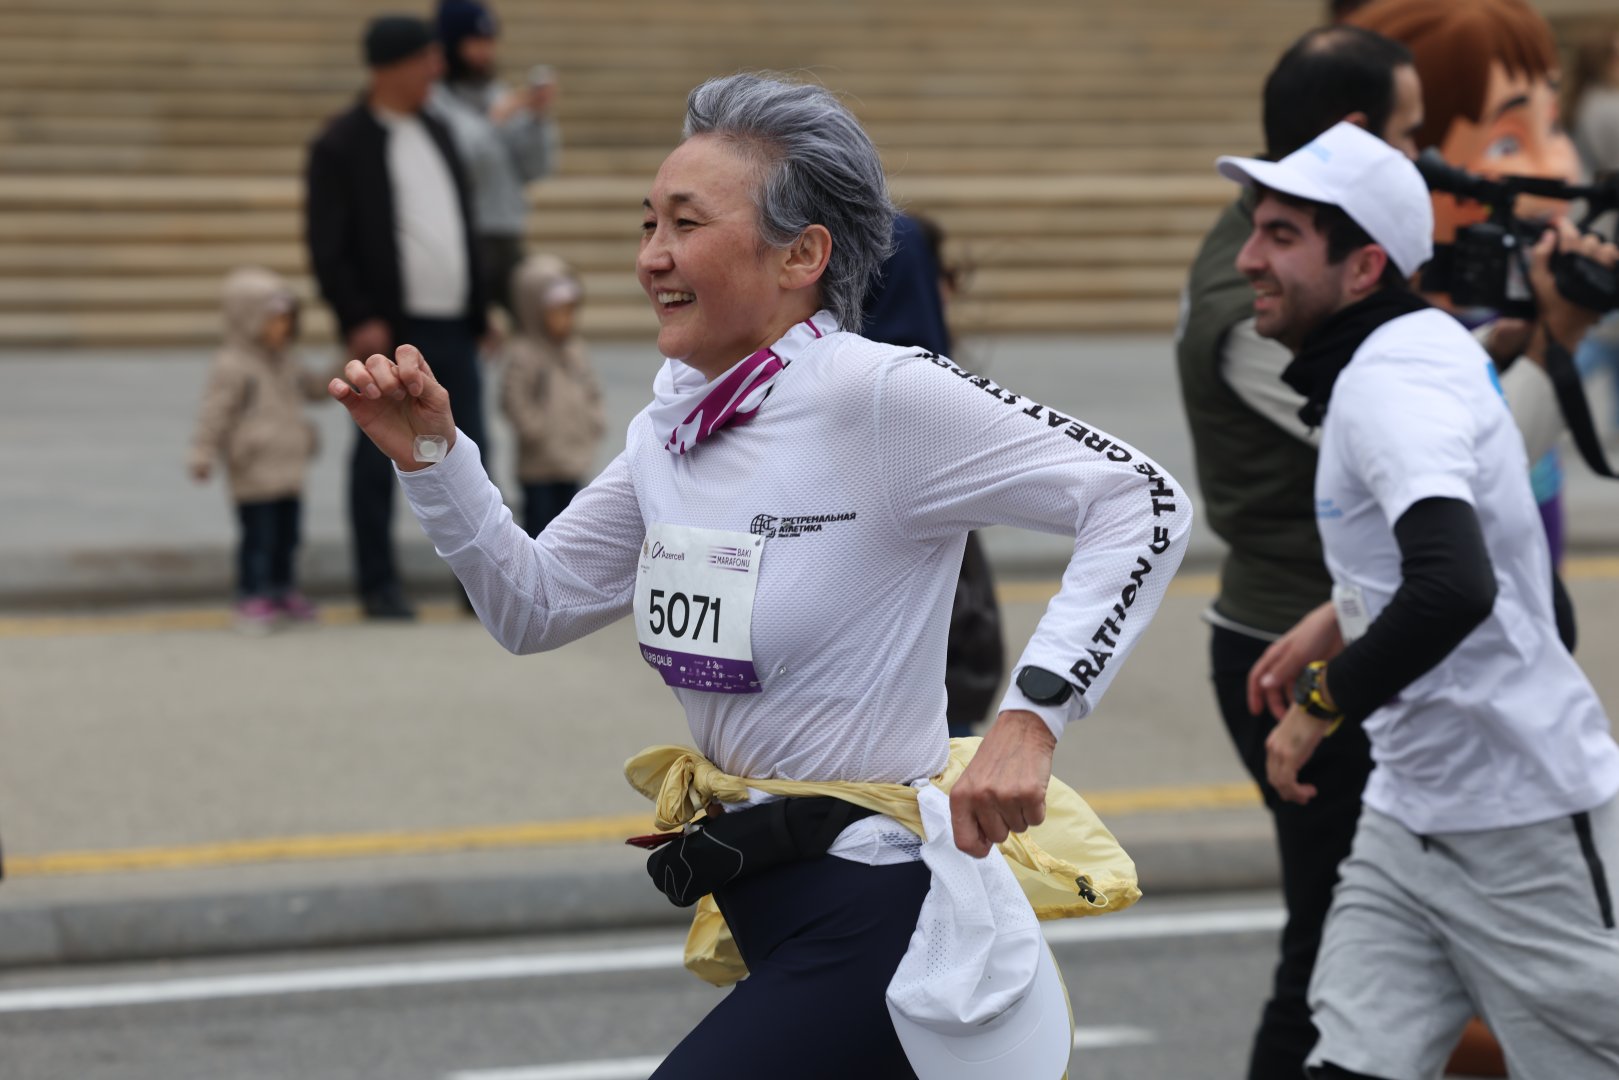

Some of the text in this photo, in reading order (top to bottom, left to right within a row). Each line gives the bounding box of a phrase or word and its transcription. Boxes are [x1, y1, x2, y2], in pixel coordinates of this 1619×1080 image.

[1022, 405, 1132, 463] GREAT
[1134, 462, 1176, 517] THE
[780, 512, 857, 525] ЭКСТРЕМАЛЬНАЯ
[661, 551, 685, 561] Azercell
[716, 556, 750, 568] MARAFONU
[737, 548, 752, 557] BAKI
[649, 589, 721, 644] 5071
[1070, 556, 1152, 695] RATHON
